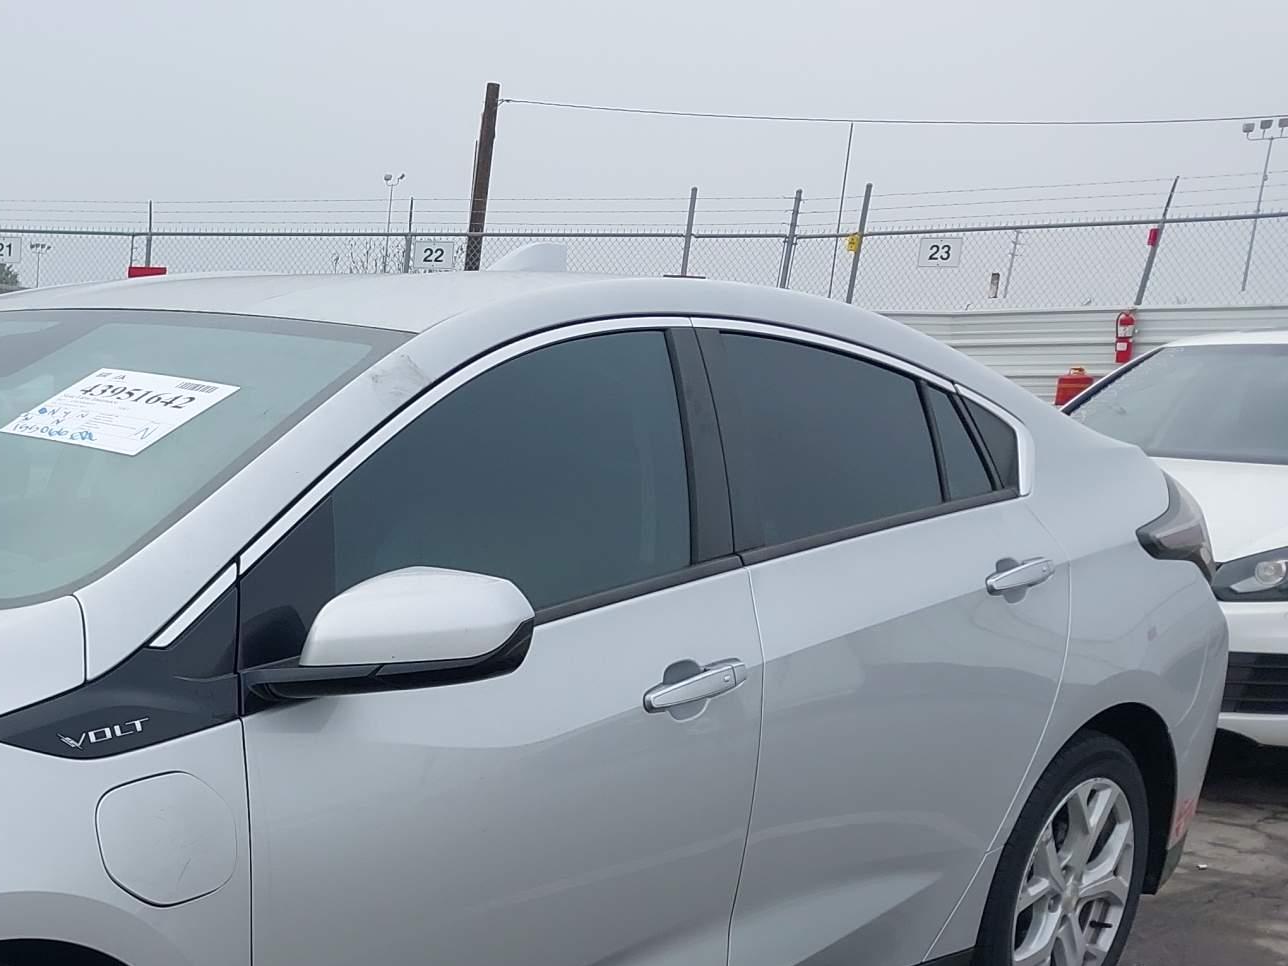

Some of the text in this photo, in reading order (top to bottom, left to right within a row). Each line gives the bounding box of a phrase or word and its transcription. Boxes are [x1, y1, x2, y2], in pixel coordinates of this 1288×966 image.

[422, 247, 445, 263] 22
[927, 244, 952, 265] 23
[80, 384, 196, 409] 43951642
[56, 717, 150, 751] VOLT
